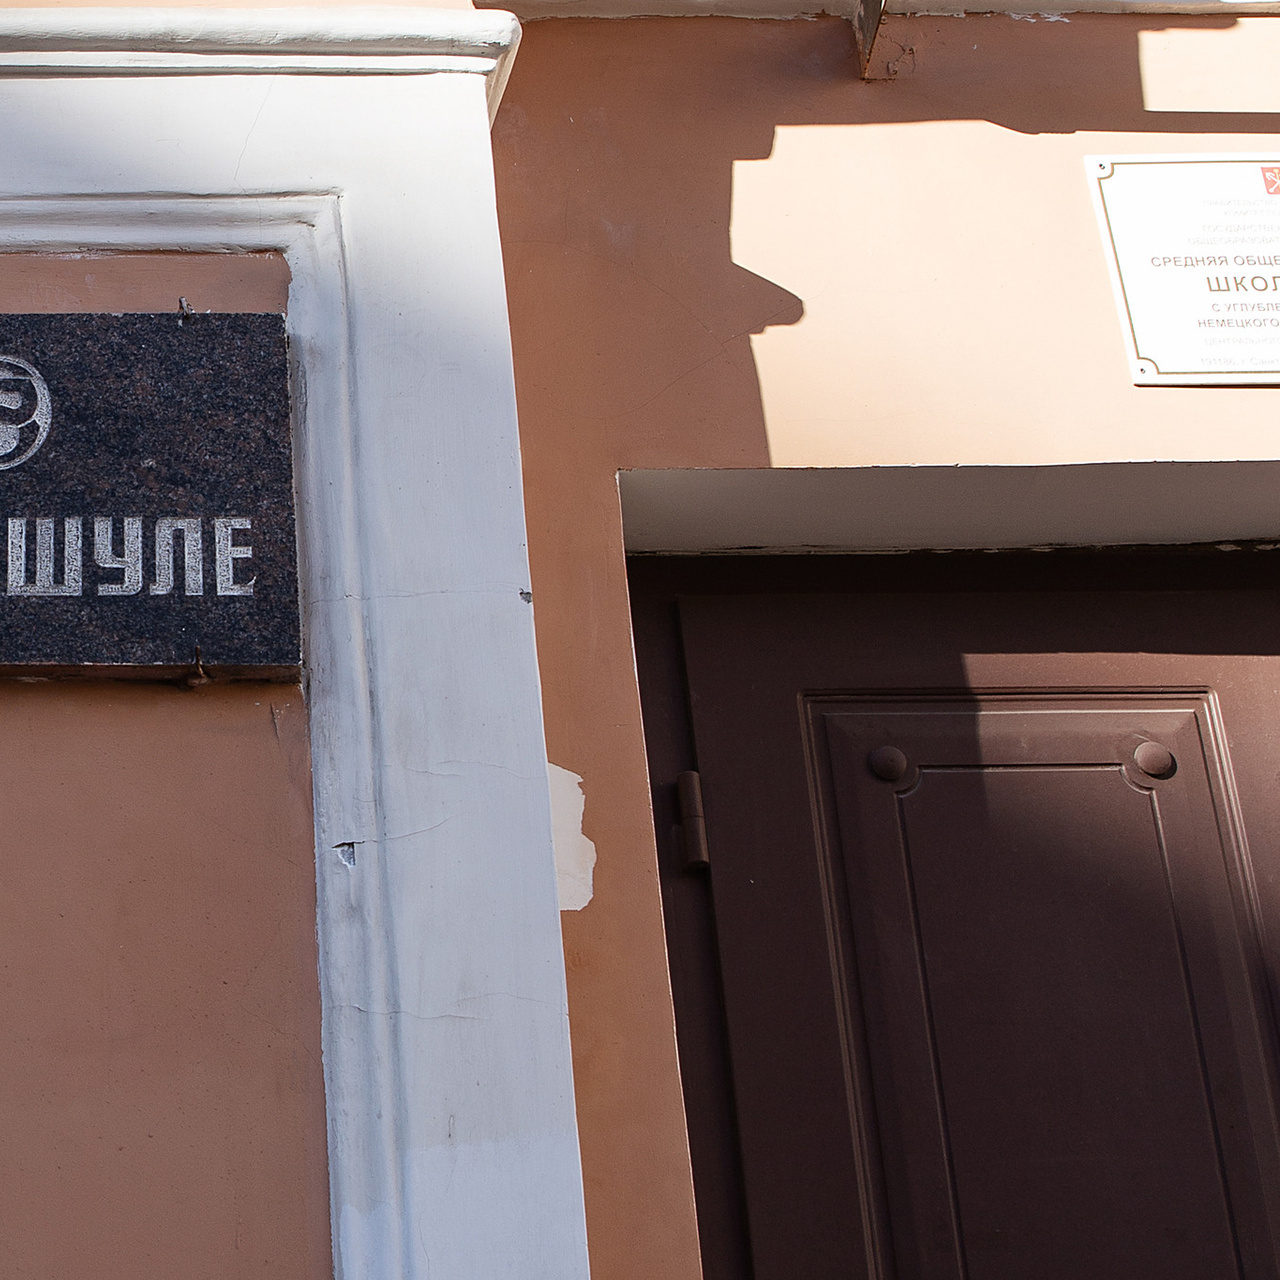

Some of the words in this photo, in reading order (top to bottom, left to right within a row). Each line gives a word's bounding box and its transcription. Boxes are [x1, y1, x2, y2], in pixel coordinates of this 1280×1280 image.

[1150, 255, 1229, 268] СРЕДНЯЯ
[1211, 303, 1221, 312] С
[1197, 318, 1280, 329] НЕМЕЦКОГО
